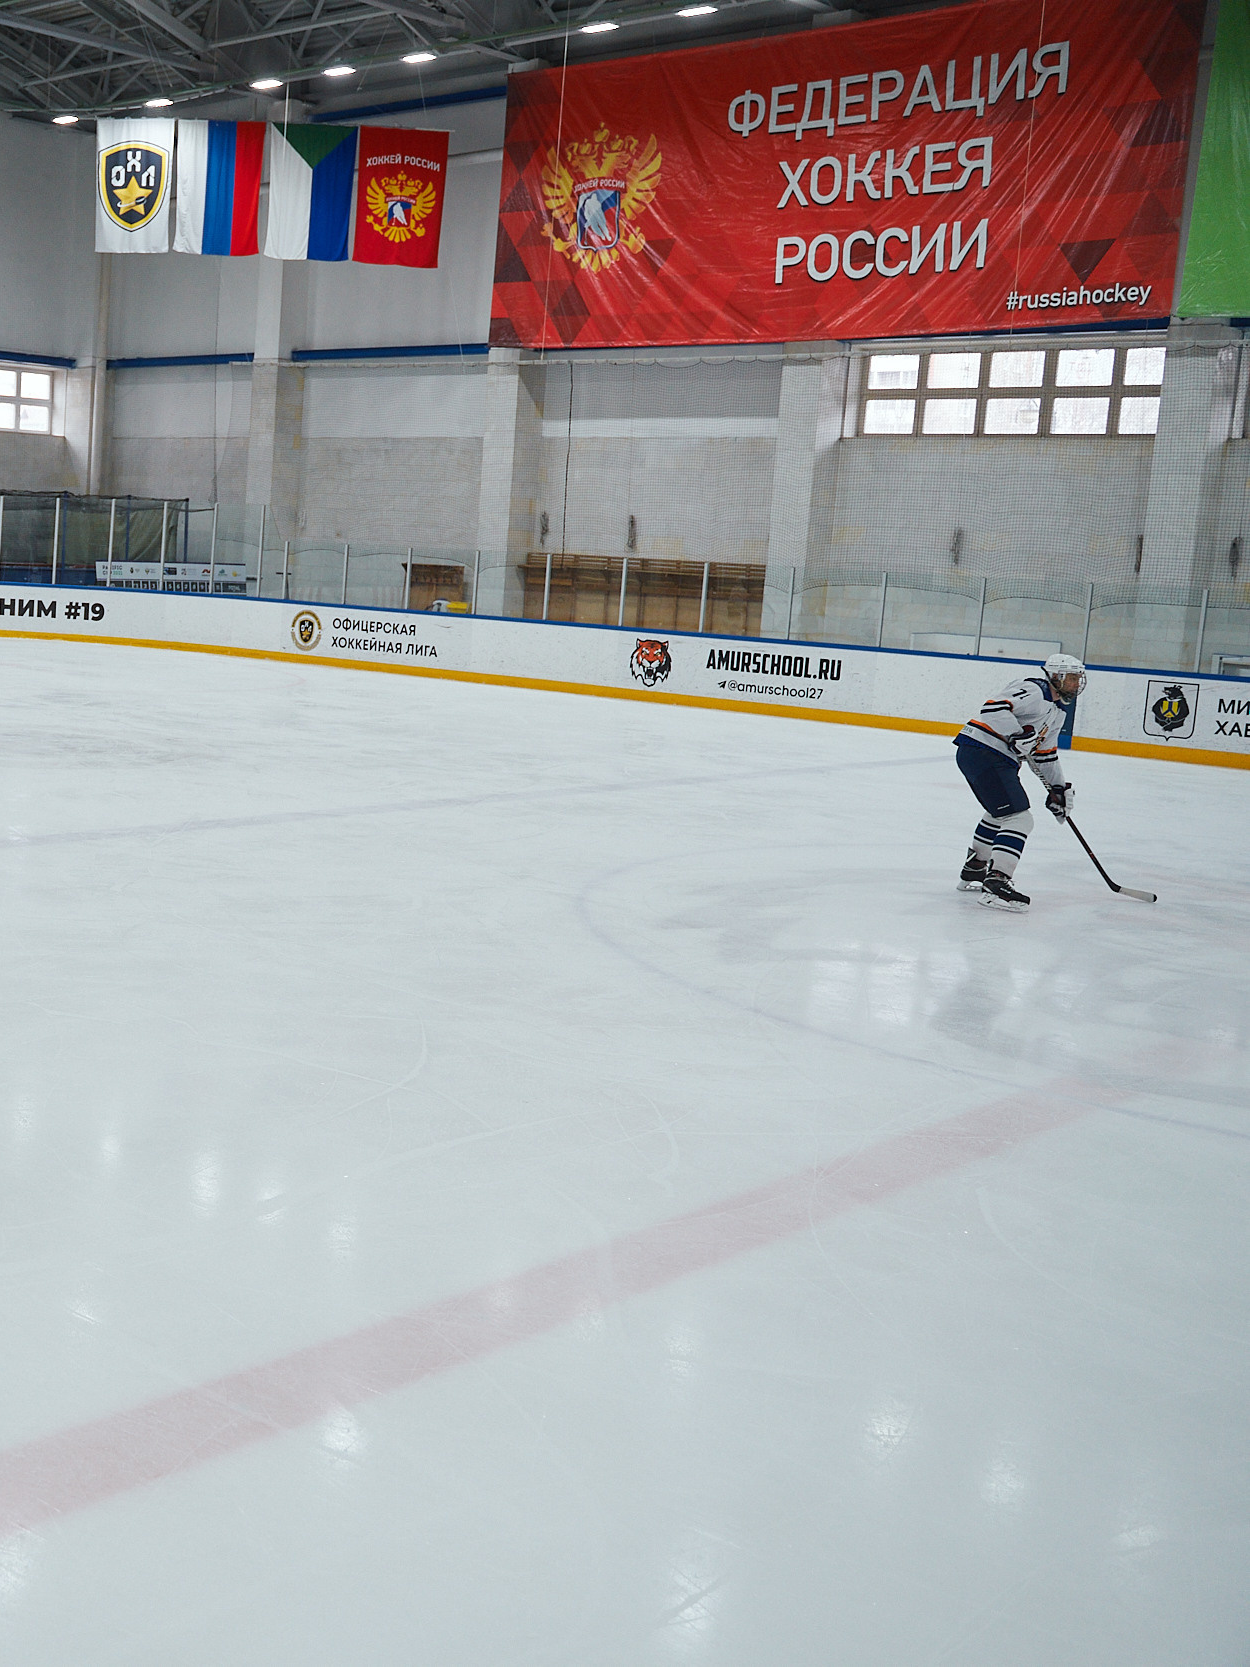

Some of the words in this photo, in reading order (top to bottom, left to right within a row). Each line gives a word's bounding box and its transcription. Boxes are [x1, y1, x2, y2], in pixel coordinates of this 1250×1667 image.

[727, 41, 1070, 142] ФЕДЕРАЦИЯ
[366, 154, 402, 167] ХОККЕЙ
[404, 155, 440, 172] РОССИИ
[776, 136, 993, 209] ХОККЕЯ
[775, 218, 989, 284] РОССИИ
[1005, 282, 1152, 310] #russiahockey
[64, 601, 105, 621] #19
[332, 617, 416, 637] ОФИЦЕРСКАЯ
[331, 636, 402, 654] ХОККЕЙНАЯ
[405, 643, 438, 658] ЛИГА
[706, 649, 842, 681] AMURSCHOOL.RU
[727, 680, 824, 700] @amurschool27
